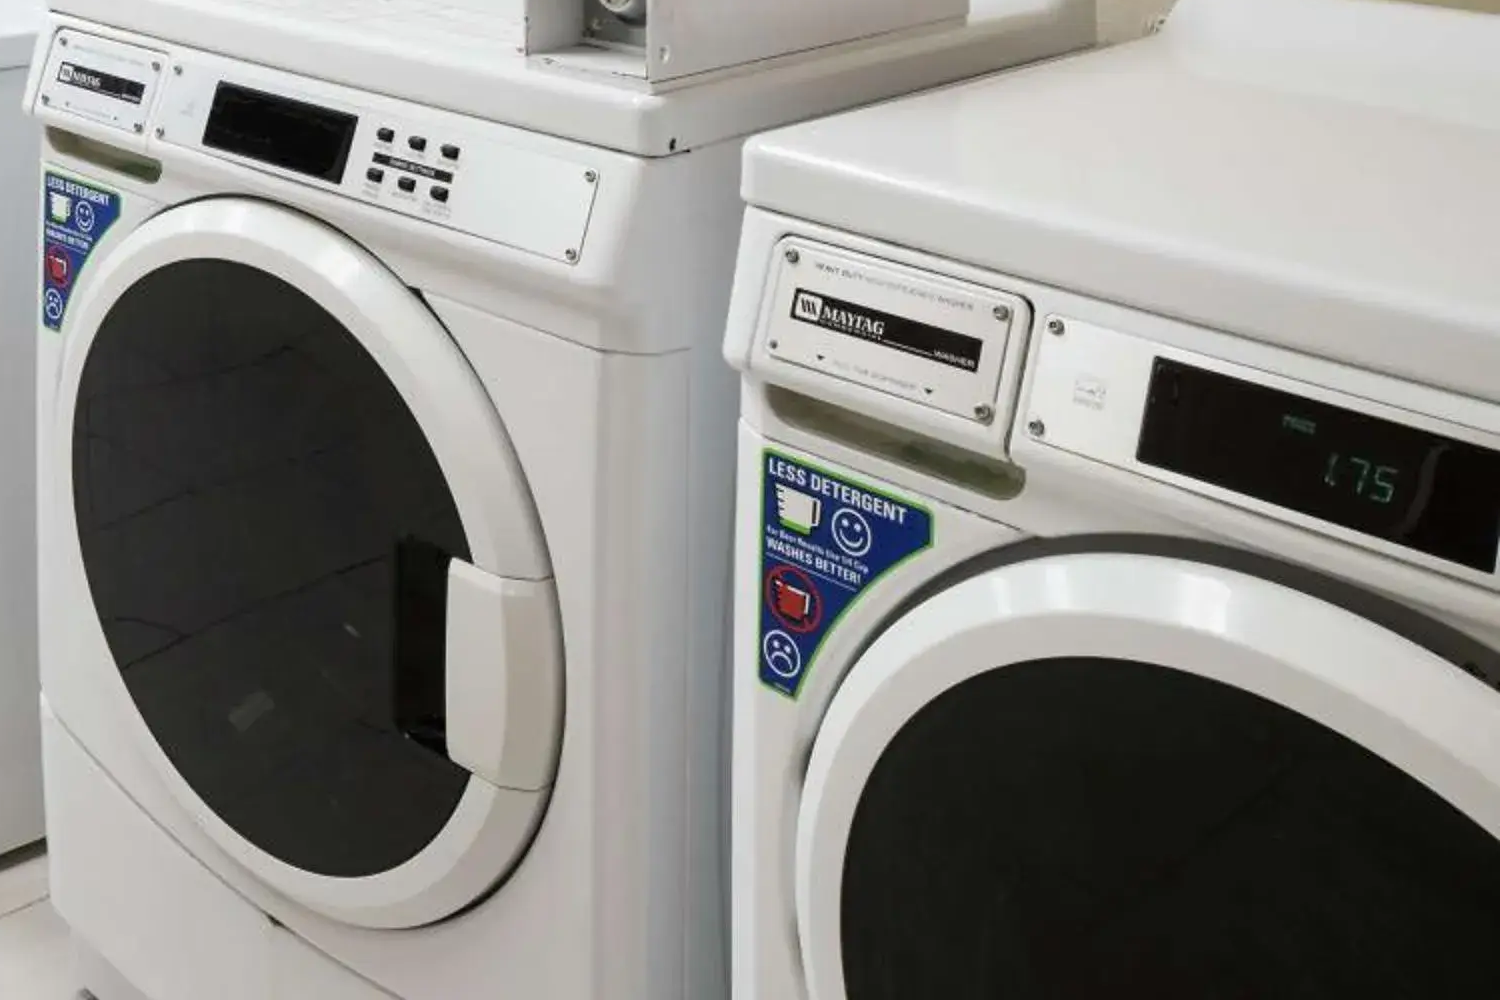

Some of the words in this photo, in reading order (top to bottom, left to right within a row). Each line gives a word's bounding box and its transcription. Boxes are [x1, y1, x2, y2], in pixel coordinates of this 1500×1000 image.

[821, 305, 886, 336] MAYTAG
[768, 456, 807, 488] LESS
[810, 473, 909, 525] DETERGENT
[766, 535, 813, 565] WASHES
[815, 557, 862, 584] BETTER!
